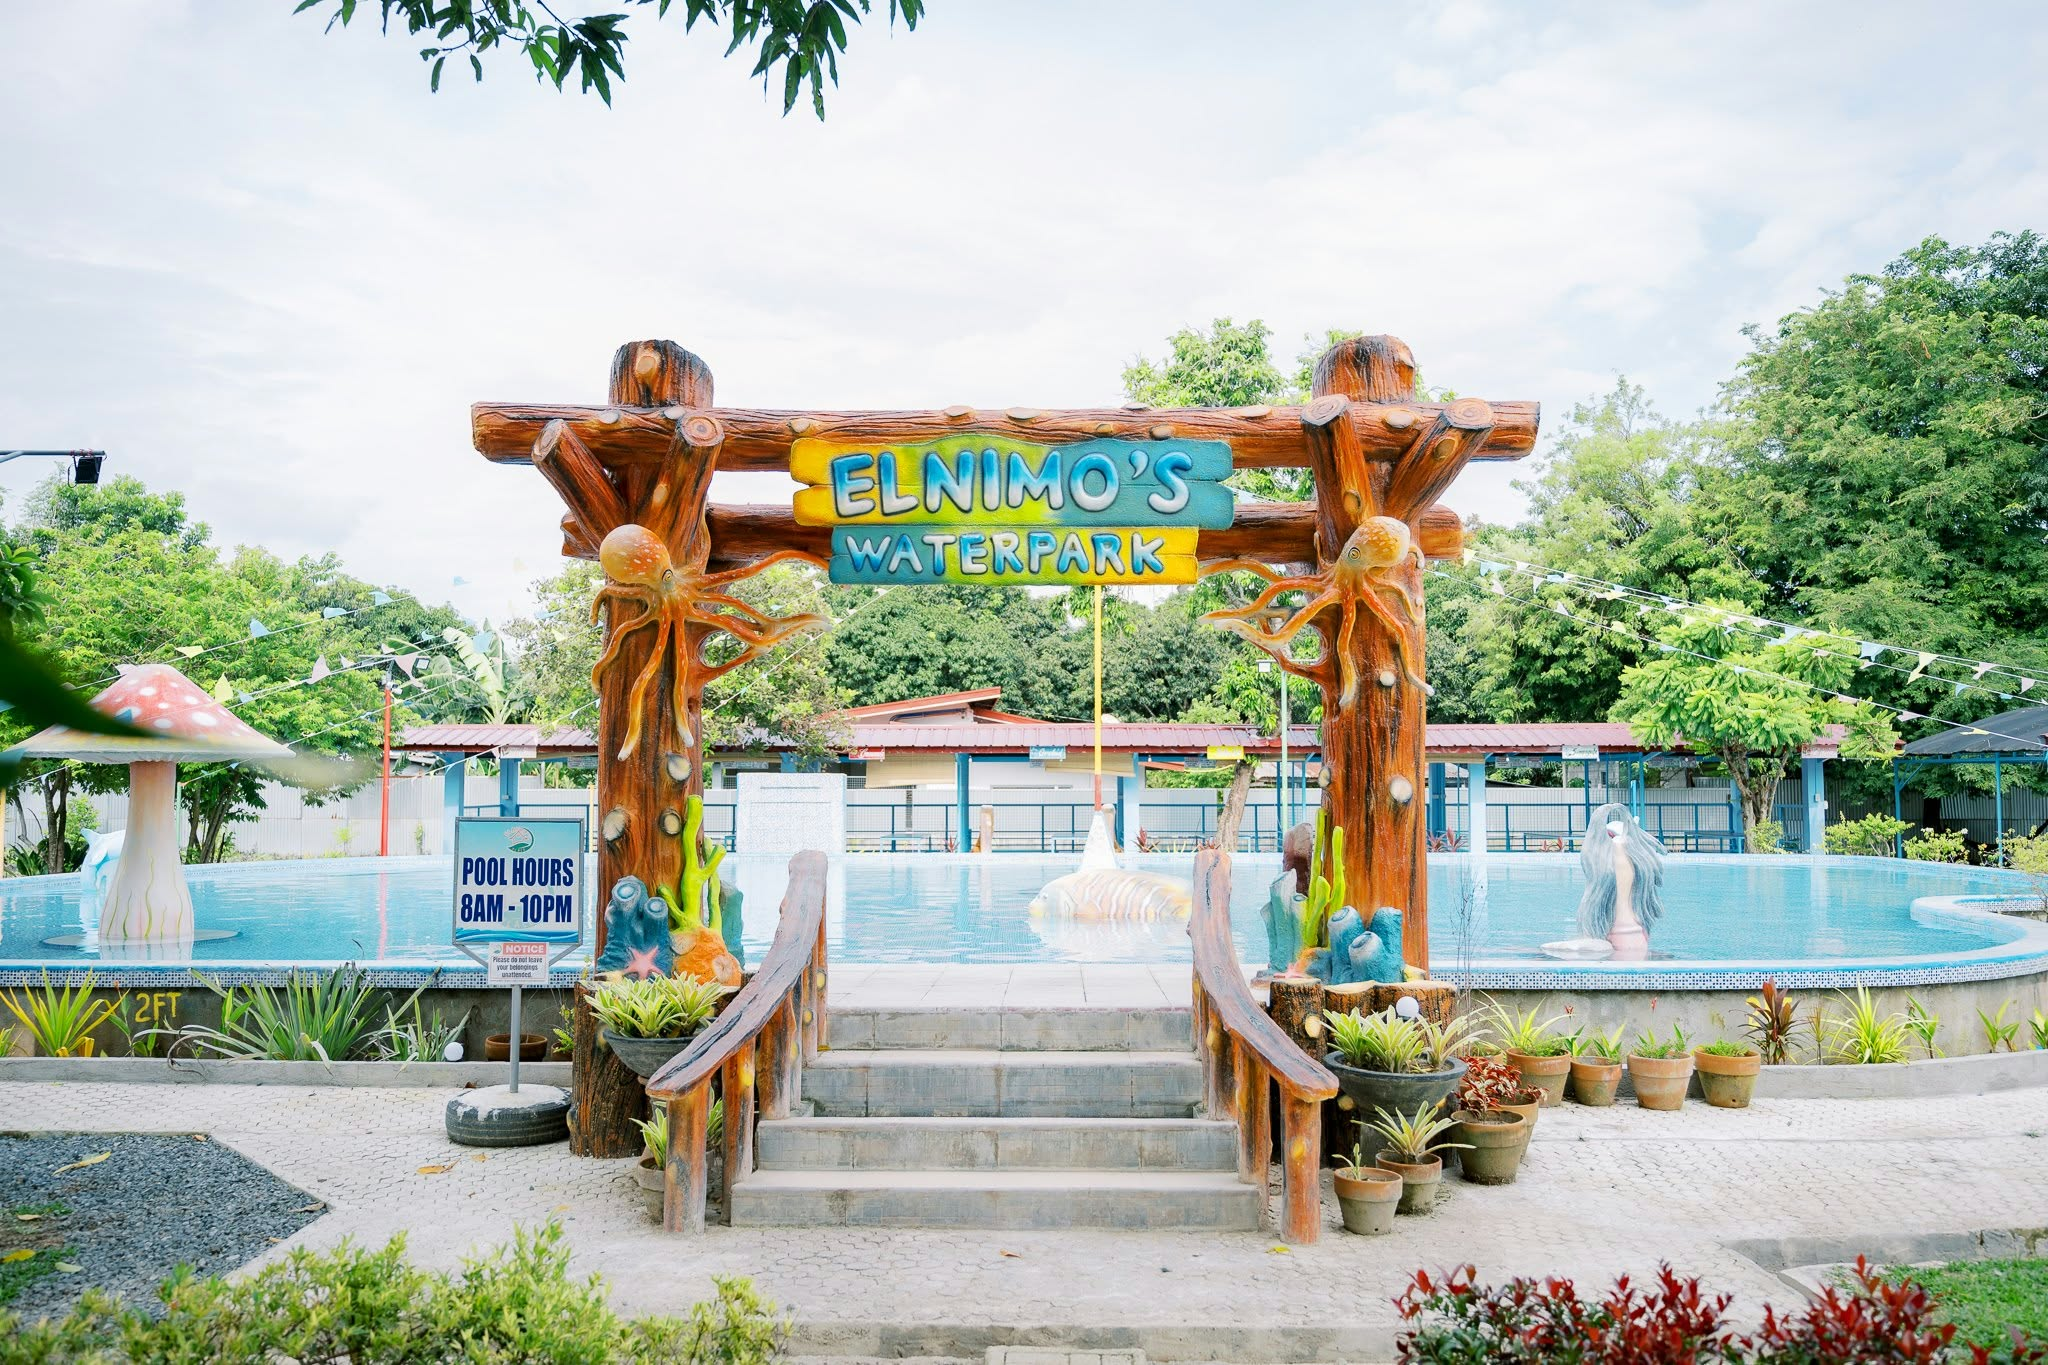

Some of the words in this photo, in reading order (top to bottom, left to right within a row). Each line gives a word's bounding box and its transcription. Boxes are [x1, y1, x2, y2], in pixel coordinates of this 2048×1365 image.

[831, 447, 1194, 517] ELNIMO'S
[844, 532, 1165, 576] WATERPARK
[462, 857, 507, 886] POOL
[512, 857, 574, 887] HOURS
[460, 893, 504, 923] 8AM
[519, 894, 572, 923] 10PM
[505, 944, 545, 954] NOTICE
[135, 992, 182, 1022] 2FT
